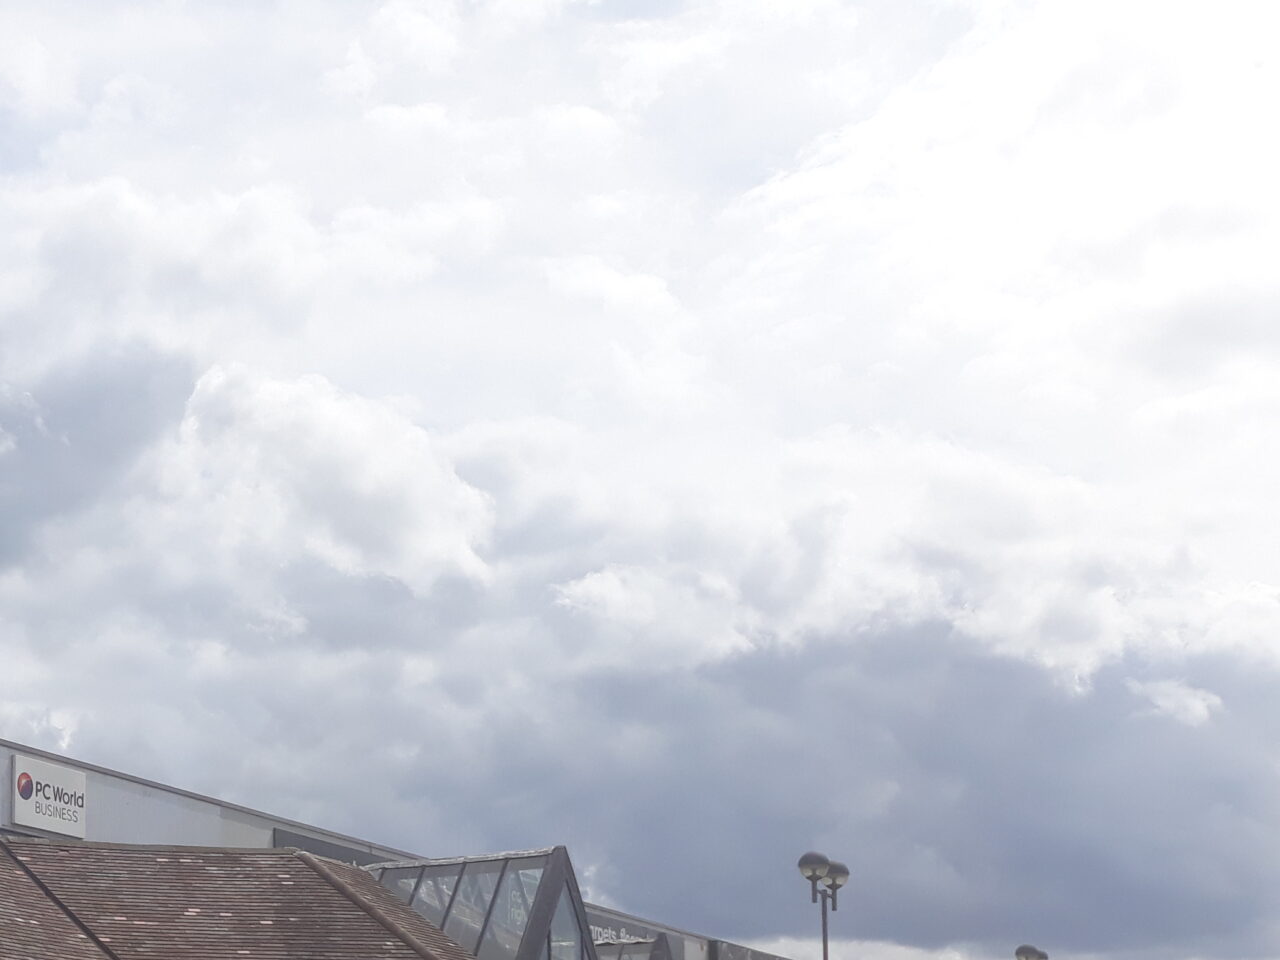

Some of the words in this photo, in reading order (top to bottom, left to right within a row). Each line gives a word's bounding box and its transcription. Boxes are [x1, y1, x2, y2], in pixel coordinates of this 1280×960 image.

[35, 781, 51, 800] PC
[53, 786, 84, 808] World
[34, 801, 78, 823] BUSINESS
